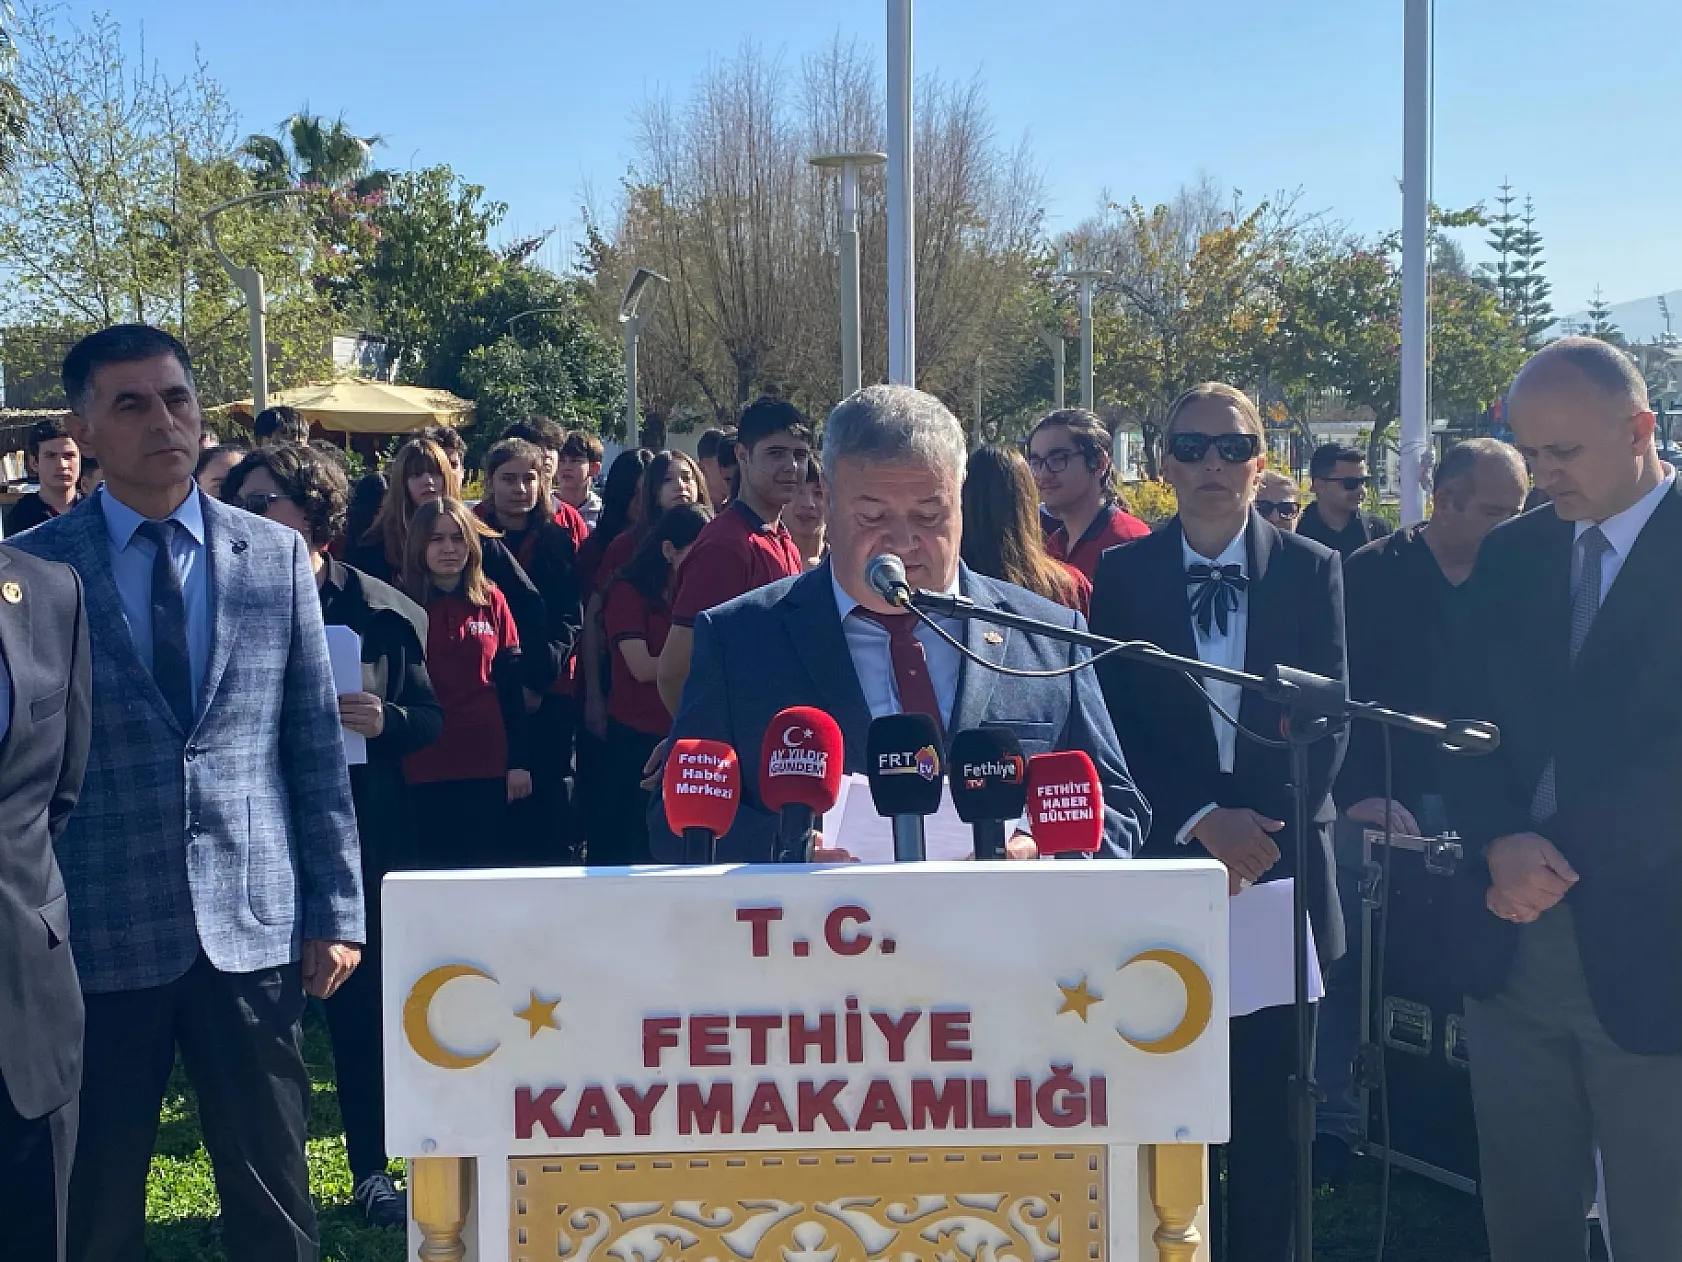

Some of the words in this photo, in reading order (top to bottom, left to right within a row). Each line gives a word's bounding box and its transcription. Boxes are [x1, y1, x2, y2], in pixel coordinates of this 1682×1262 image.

[678, 753, 732, 768] Fethiye
[788, 748, 828, 763] YILDIZ
[879, 752, 913, 767] FRT
[682, 768, 728, 783] Haber
[919, 762, 933, 776] tv
[963, 761, 1016, 779] Fethiye
[676, 783, 733, 799] Merkezi
[1037, 781, 1091, 797] FETHİYE
[1042, 796, 1088, 810] HABER
[1039, 806, 1094, 823] BÜLTENİ
[641, 995, 973, 1067] FETHİYE
[514, 1063, 1109, 1139] KAYMAKAMLIĞI
